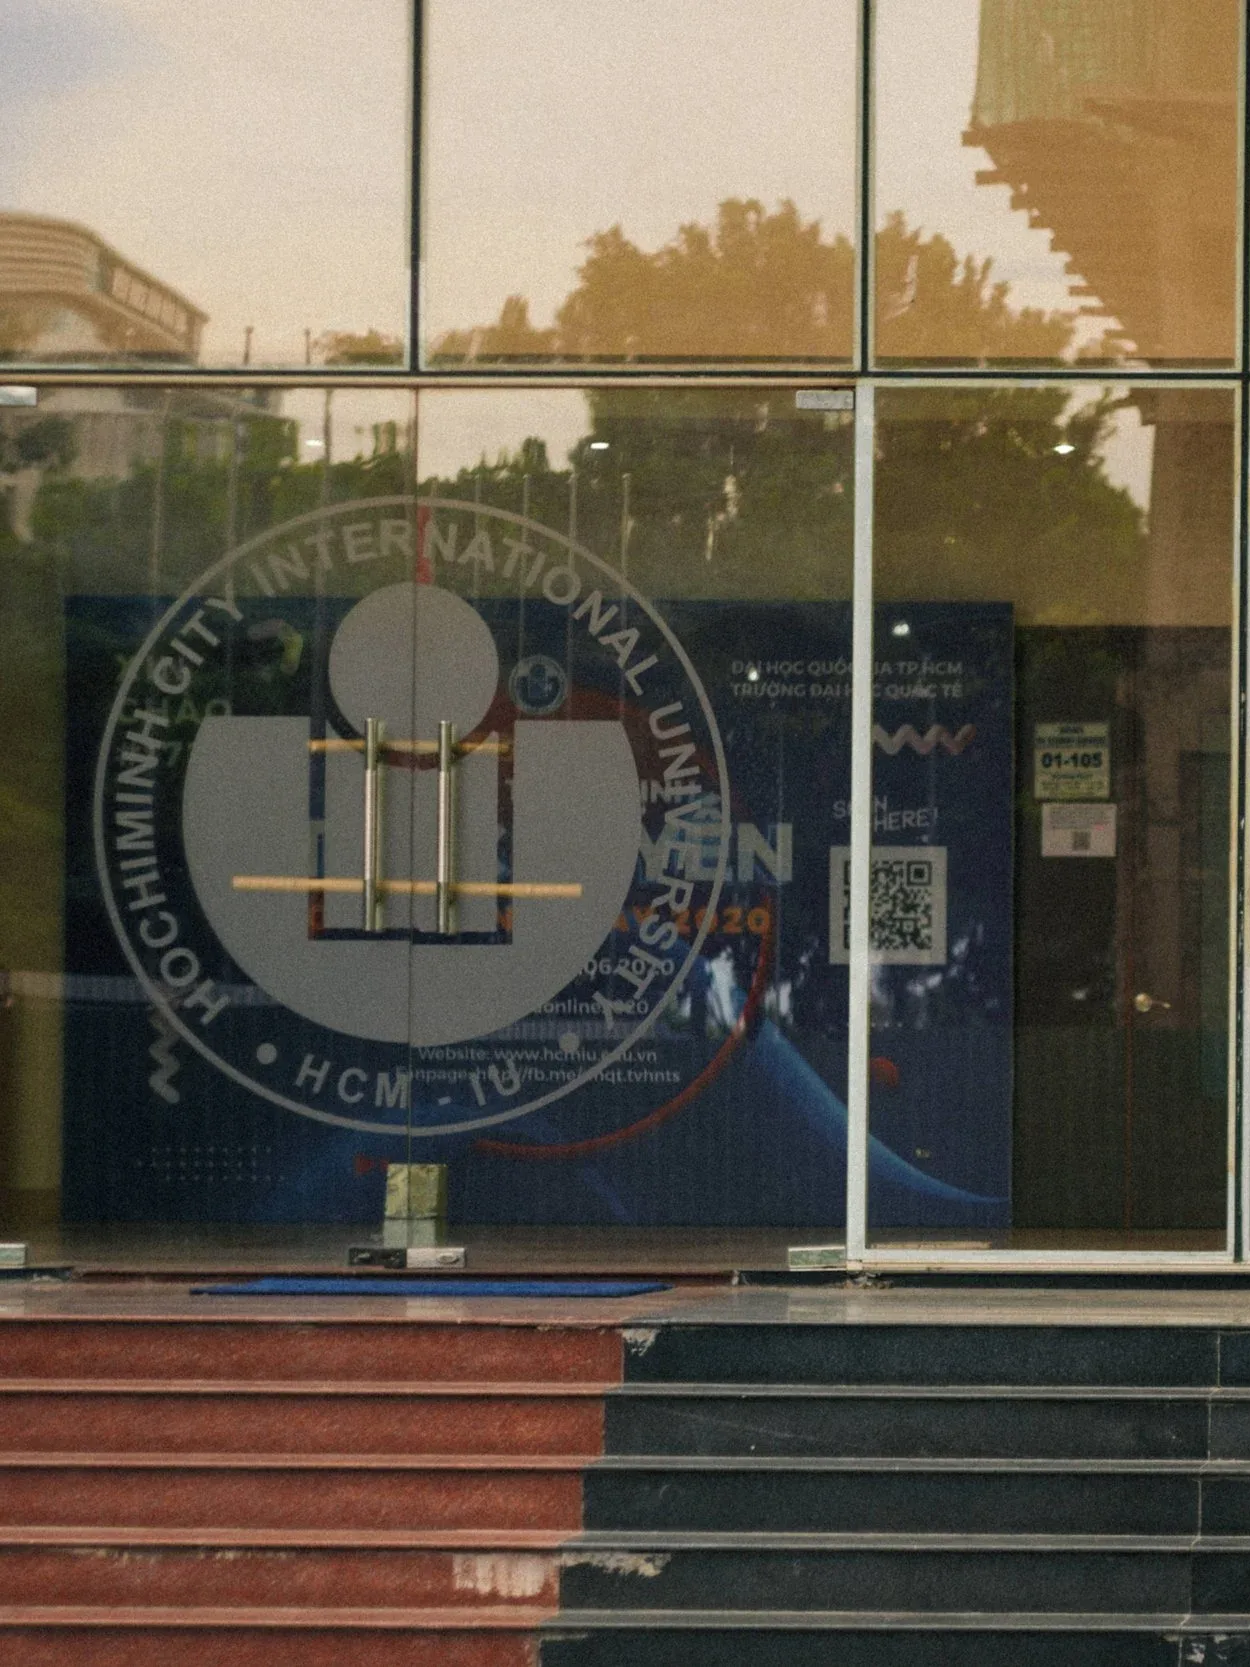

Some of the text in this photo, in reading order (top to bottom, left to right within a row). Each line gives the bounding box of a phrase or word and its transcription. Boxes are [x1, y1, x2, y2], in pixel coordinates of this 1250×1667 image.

[114, 518, 703, 1031] HOCHIMINH CITY INTERNATIONAL UNIVERSITY
[1042, 752, 1102, 768] 01-105
[292, 1052, 409, 1109] HCM
[469, 1057, 521, 1107] IU
